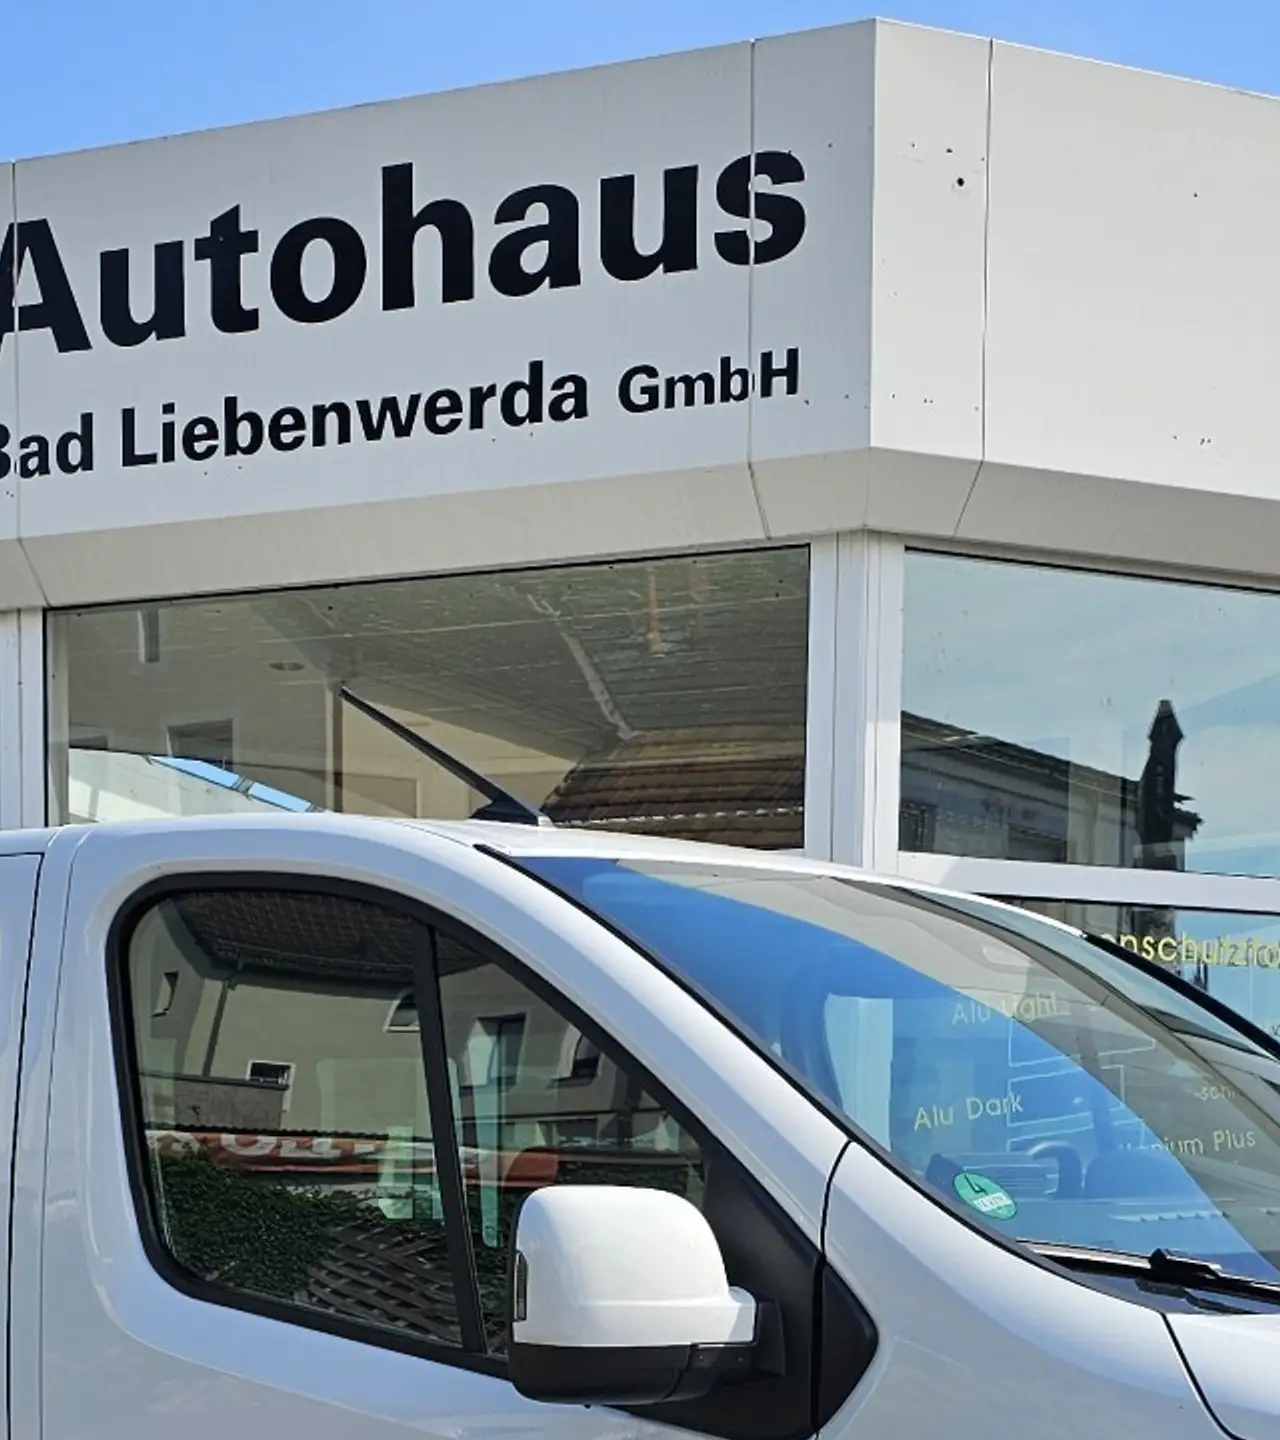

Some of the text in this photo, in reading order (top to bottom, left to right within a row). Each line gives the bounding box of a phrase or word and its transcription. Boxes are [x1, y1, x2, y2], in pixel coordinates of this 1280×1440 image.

[121, 360, 589, 467] Liebenwerda
[618, 347, 800, 413] GmbH
[951, 1002, 992, 1025] Alu
[914, 1092, 1024, 1132] Alu Dark
[1213, 1129, 1257, 1151] Plus
[963, 1174, 989, 1196] 4
